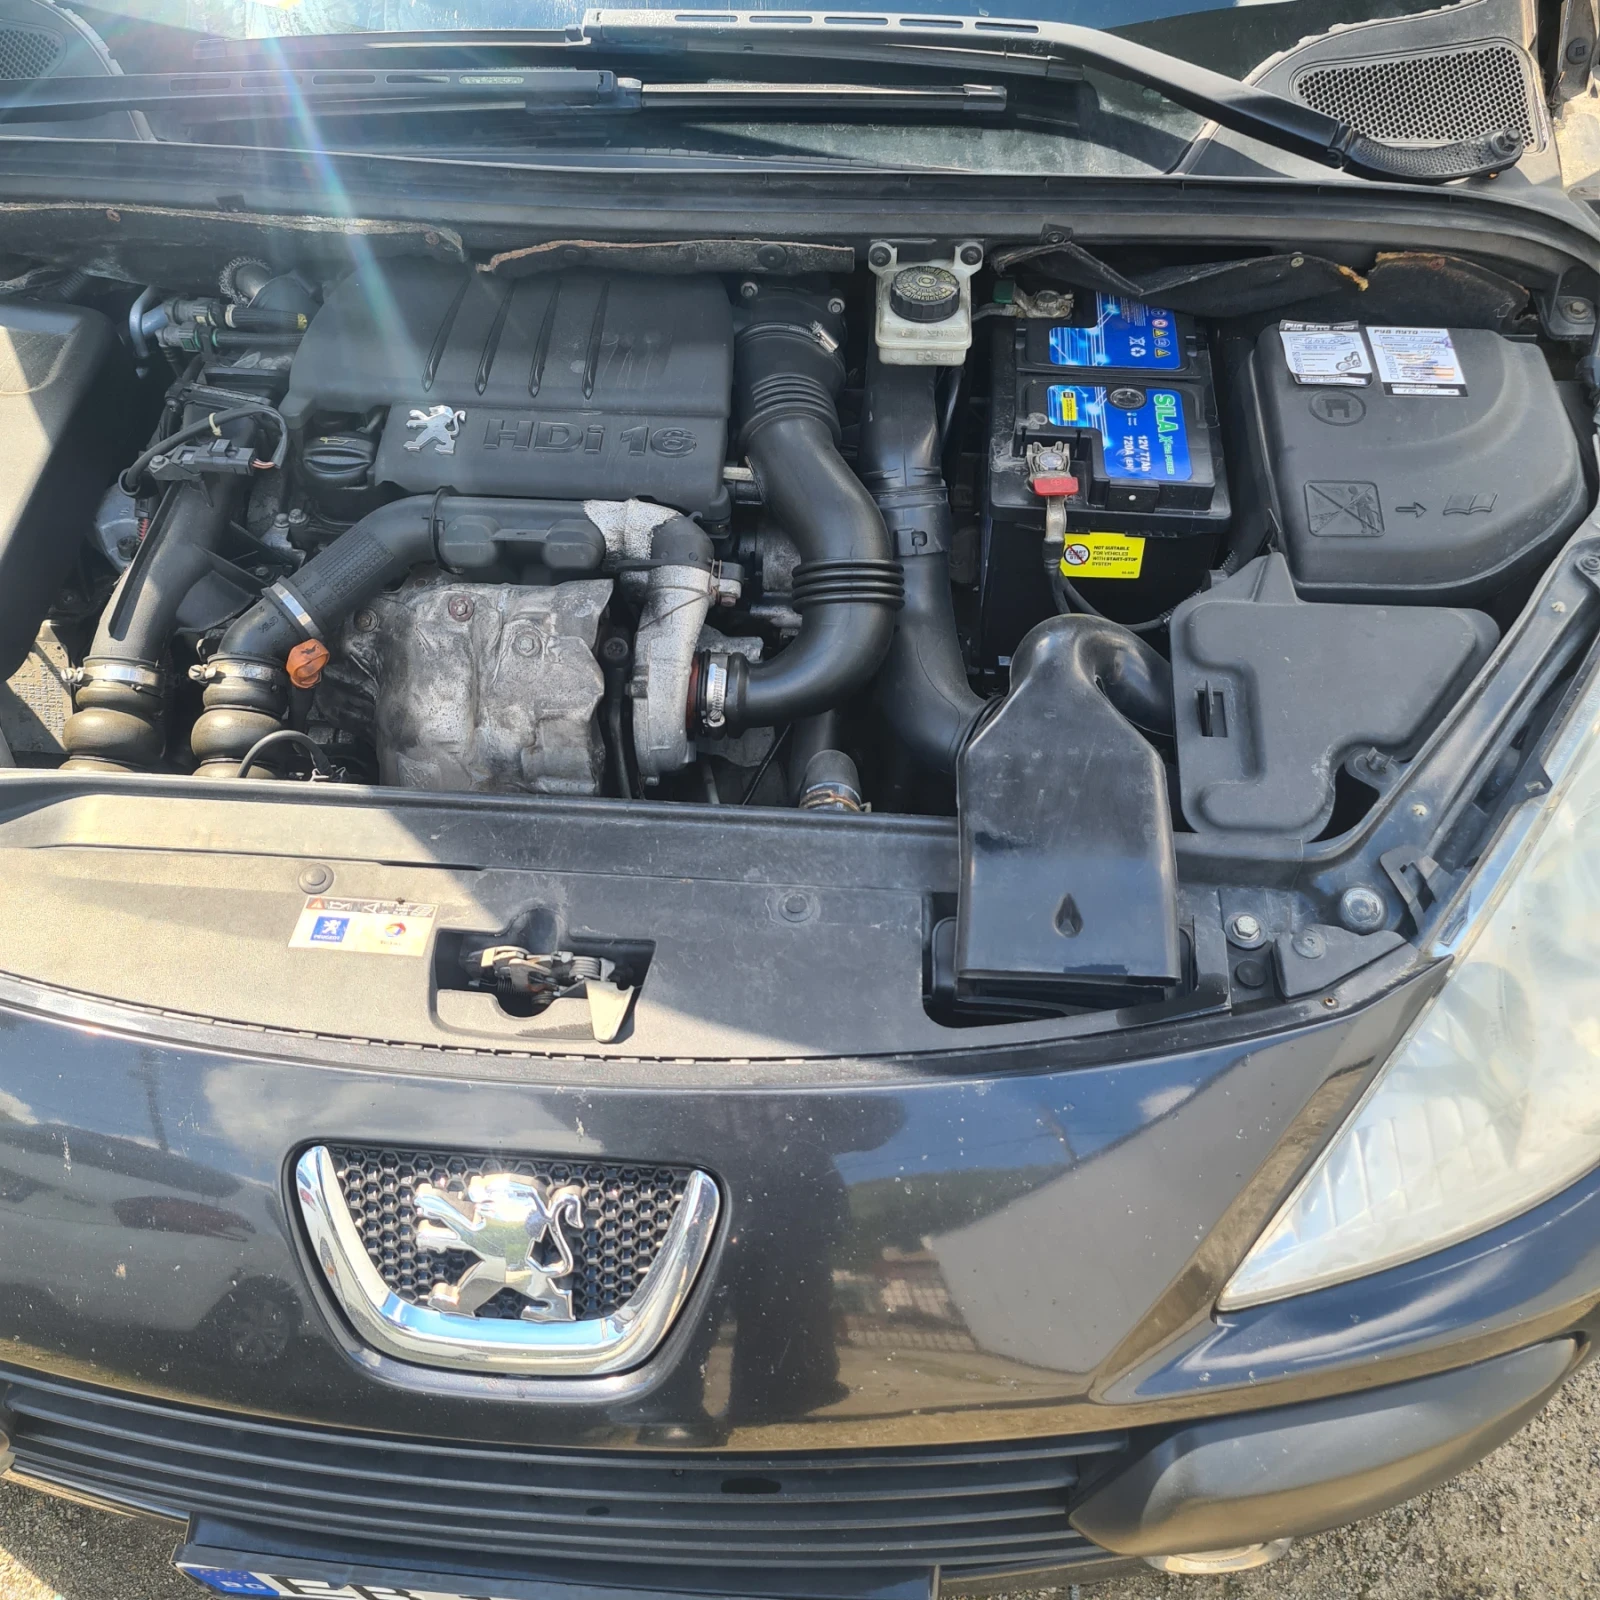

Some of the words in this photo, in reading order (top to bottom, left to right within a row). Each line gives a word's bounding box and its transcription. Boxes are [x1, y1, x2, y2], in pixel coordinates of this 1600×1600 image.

[916, 351, 955, 361] BOSCH
[1153, 393, 1179, 433] SILA
[483, 418, 606, 455] HDi
[620, 424, 698, 459] 16
[1123, 435, 1135, 455] 720A
[1138, 434, 1149, 450] 12V
[1140, 451, 1152, 472] 77Ah
[220, 1580, 267, 1590] BG
